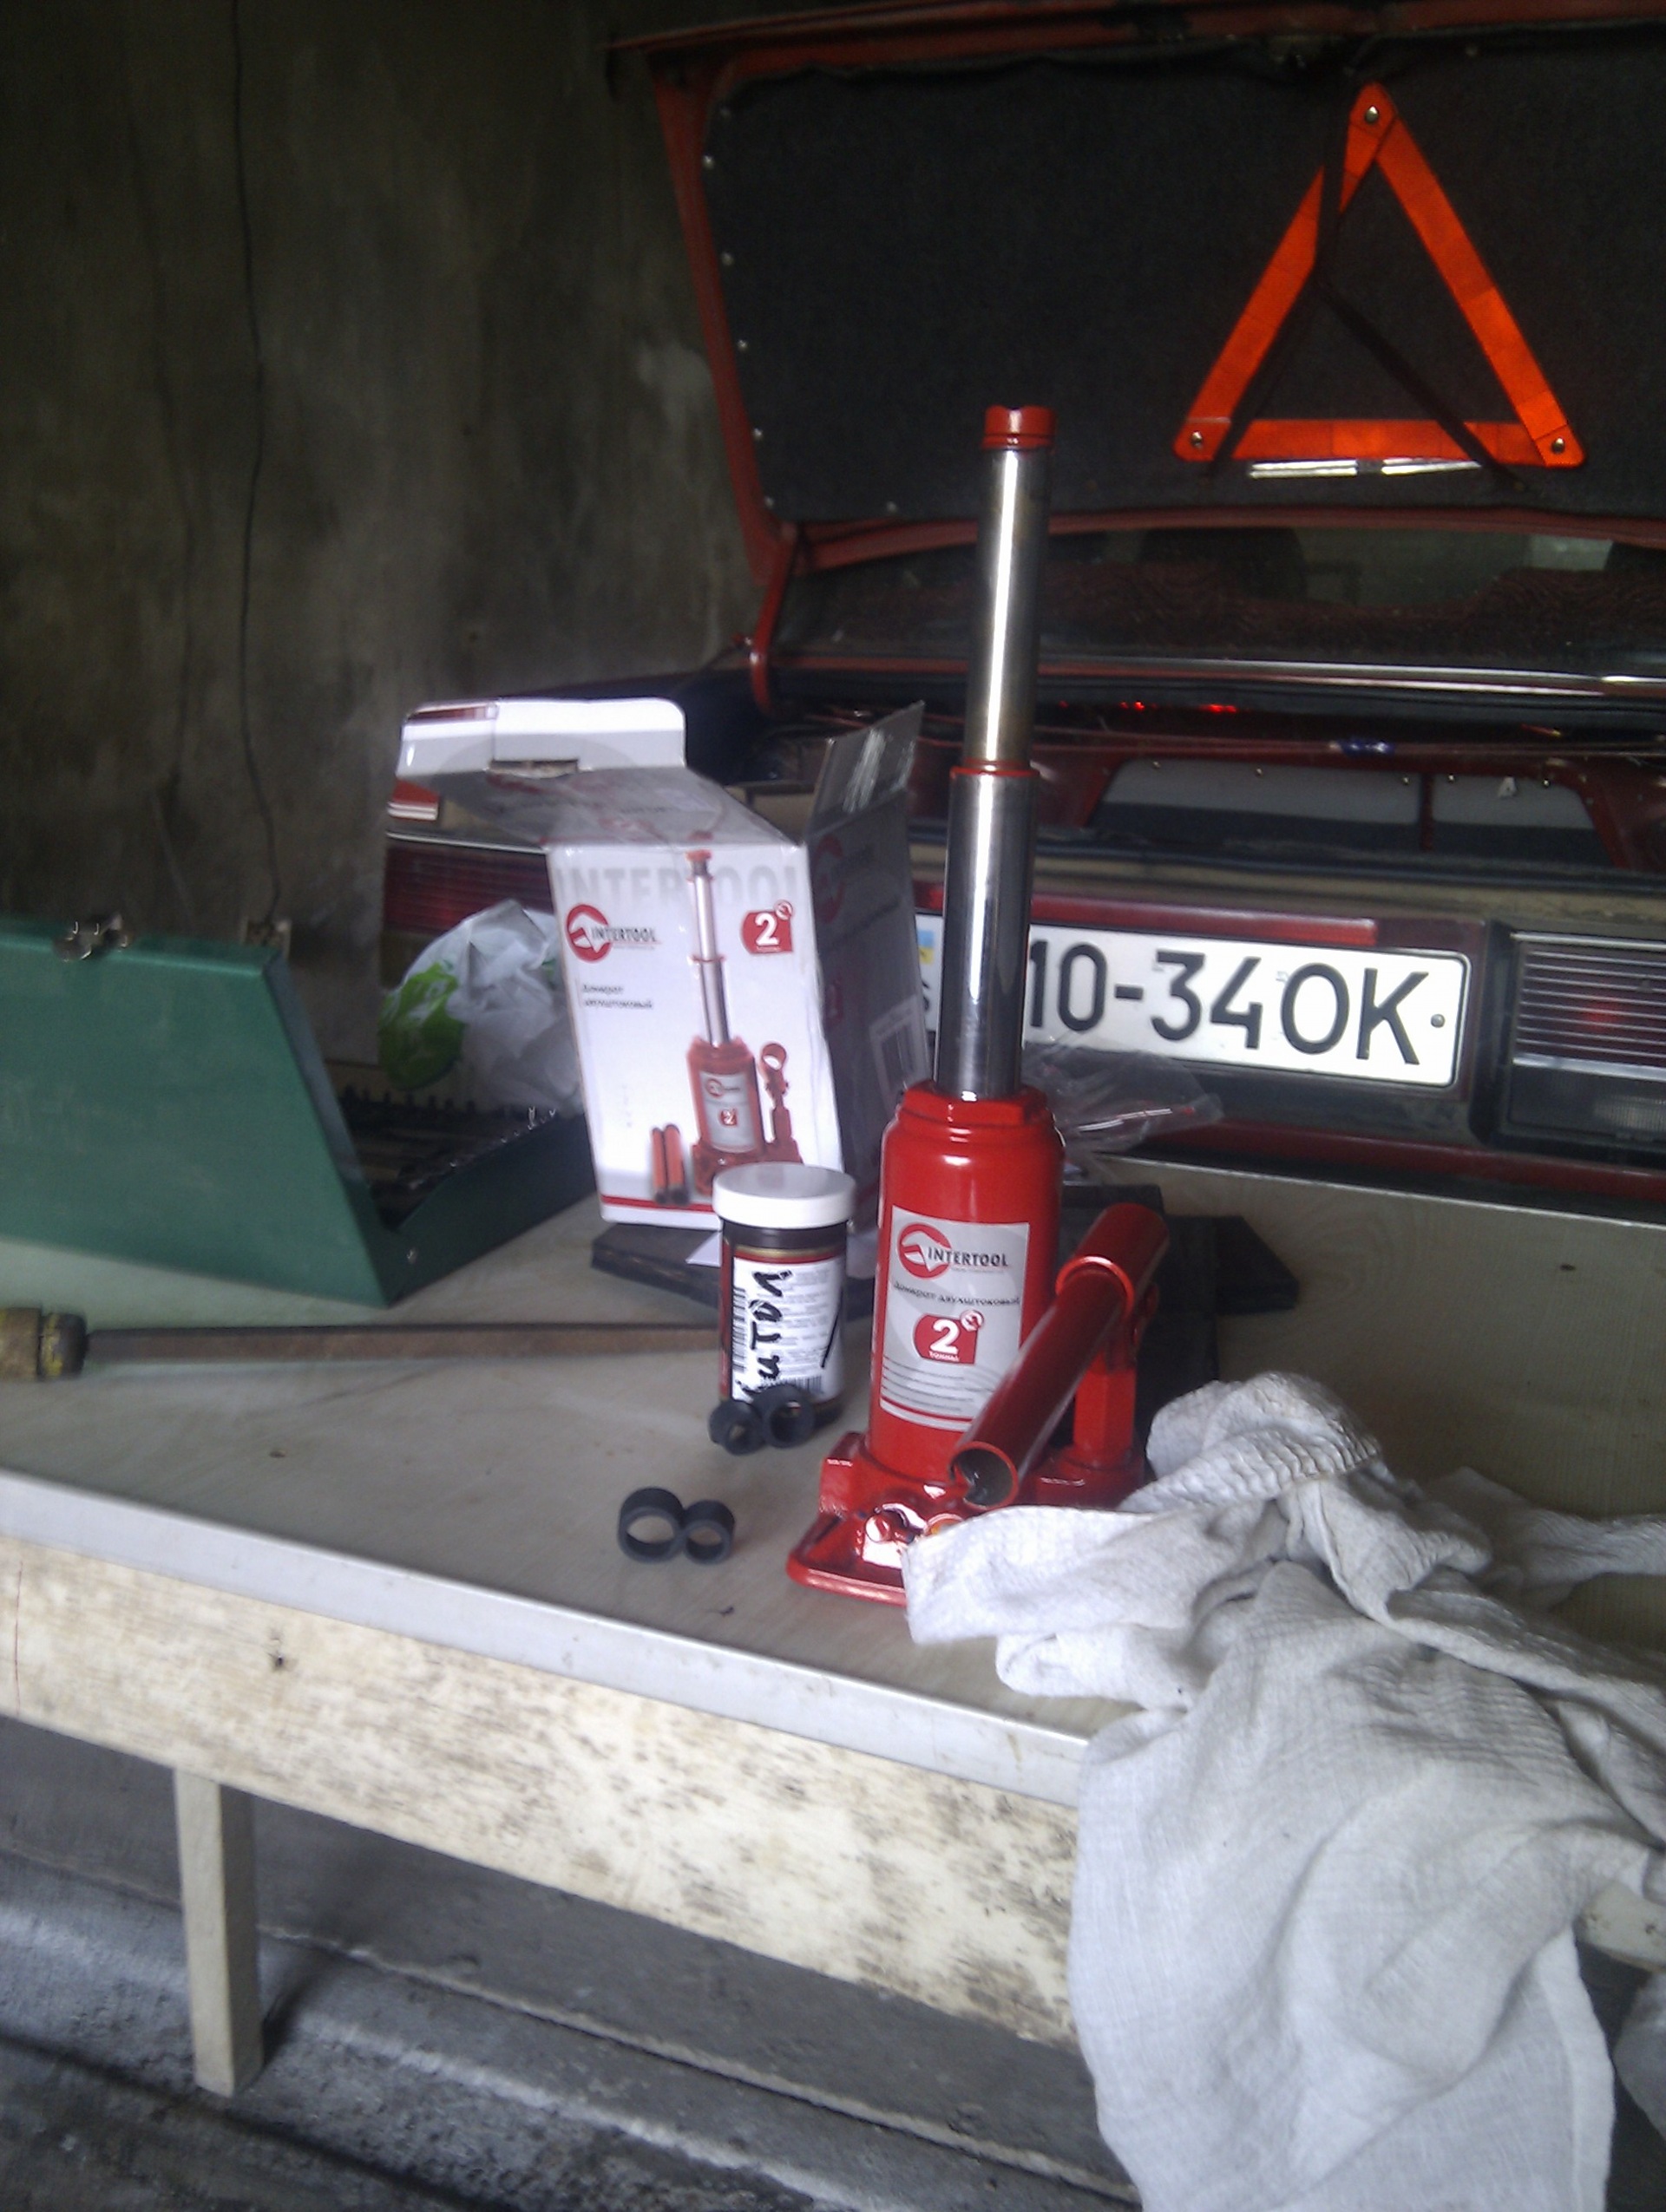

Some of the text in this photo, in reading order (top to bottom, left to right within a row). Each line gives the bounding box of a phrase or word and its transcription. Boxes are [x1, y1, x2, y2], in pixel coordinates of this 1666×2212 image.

[591, 926, 658, 942] INTERTOOL
[754, 913, 779, 946] 2
[928, 1247, 1008, 1267] INTERTOOL
[929, 1319, 961, 1354] 2
